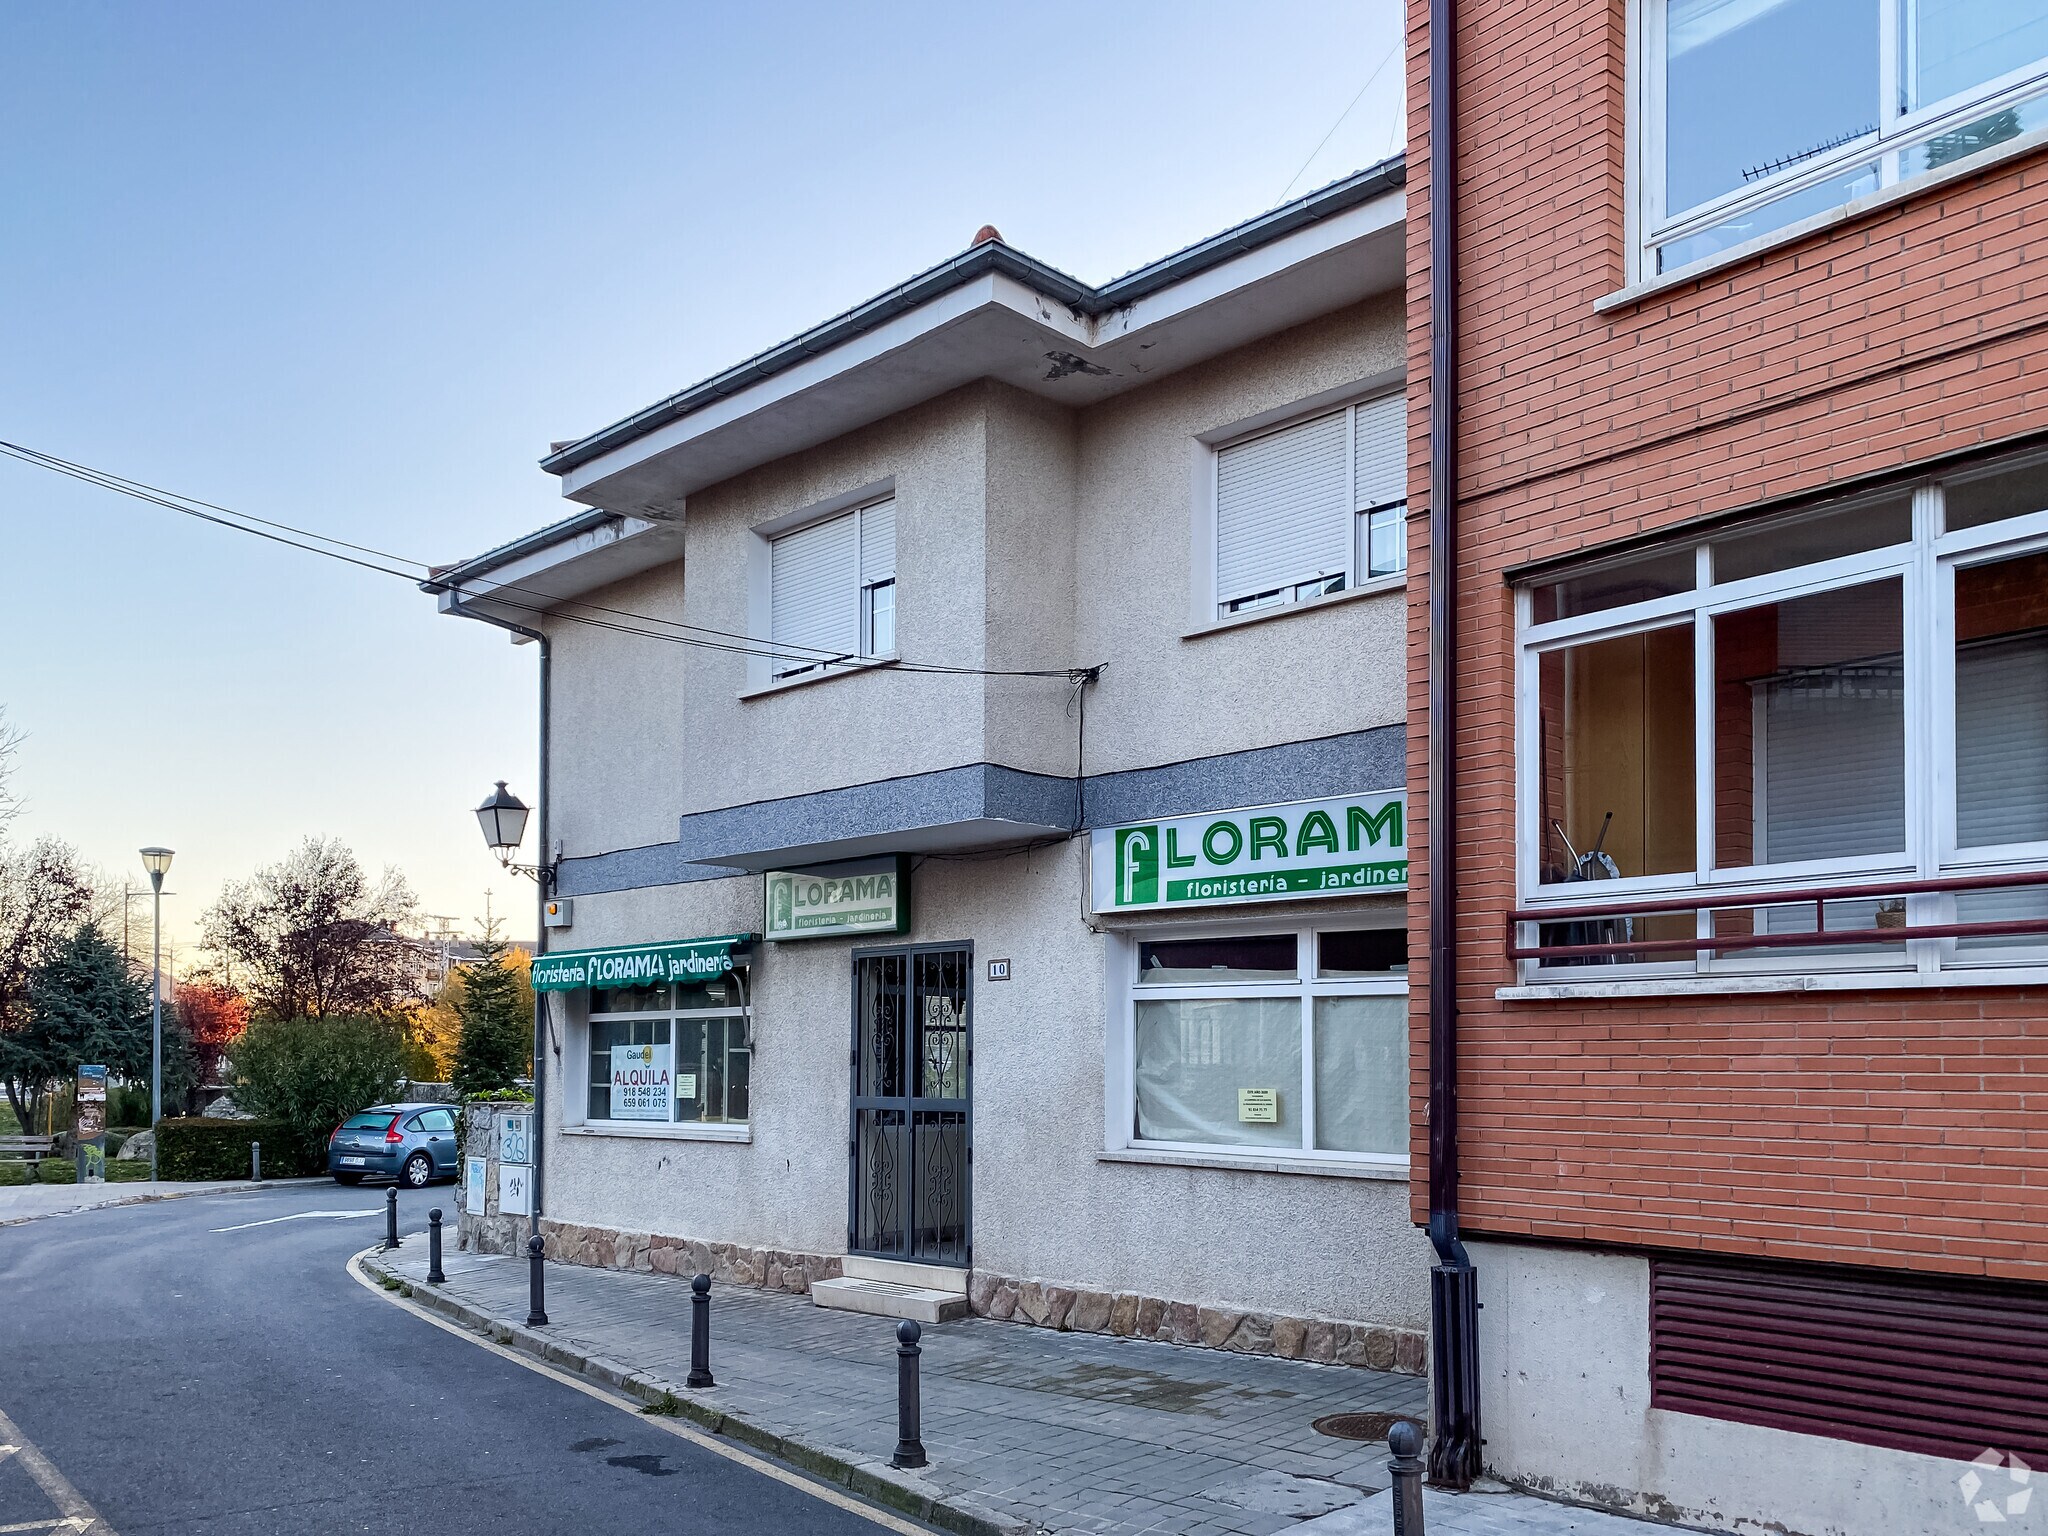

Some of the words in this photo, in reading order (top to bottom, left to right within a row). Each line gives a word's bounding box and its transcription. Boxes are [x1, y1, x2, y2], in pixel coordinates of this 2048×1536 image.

[1186, 874, 1288, 898] floristería
[667, 948, 734, 982] jardinería
[993, 963, 1005, 976] 10
[613, 1069, 670, 1086] ALQUILA
[623, 1087, 636, 1097] 918
[637, 1087, 651, 1097] 548
[652, 1087, 667, 1097] 234
[623, 1098, 636, 1108] 659
[637, 1098, 650, 1108] 061
[652, 1098, 667, 1108] 075
